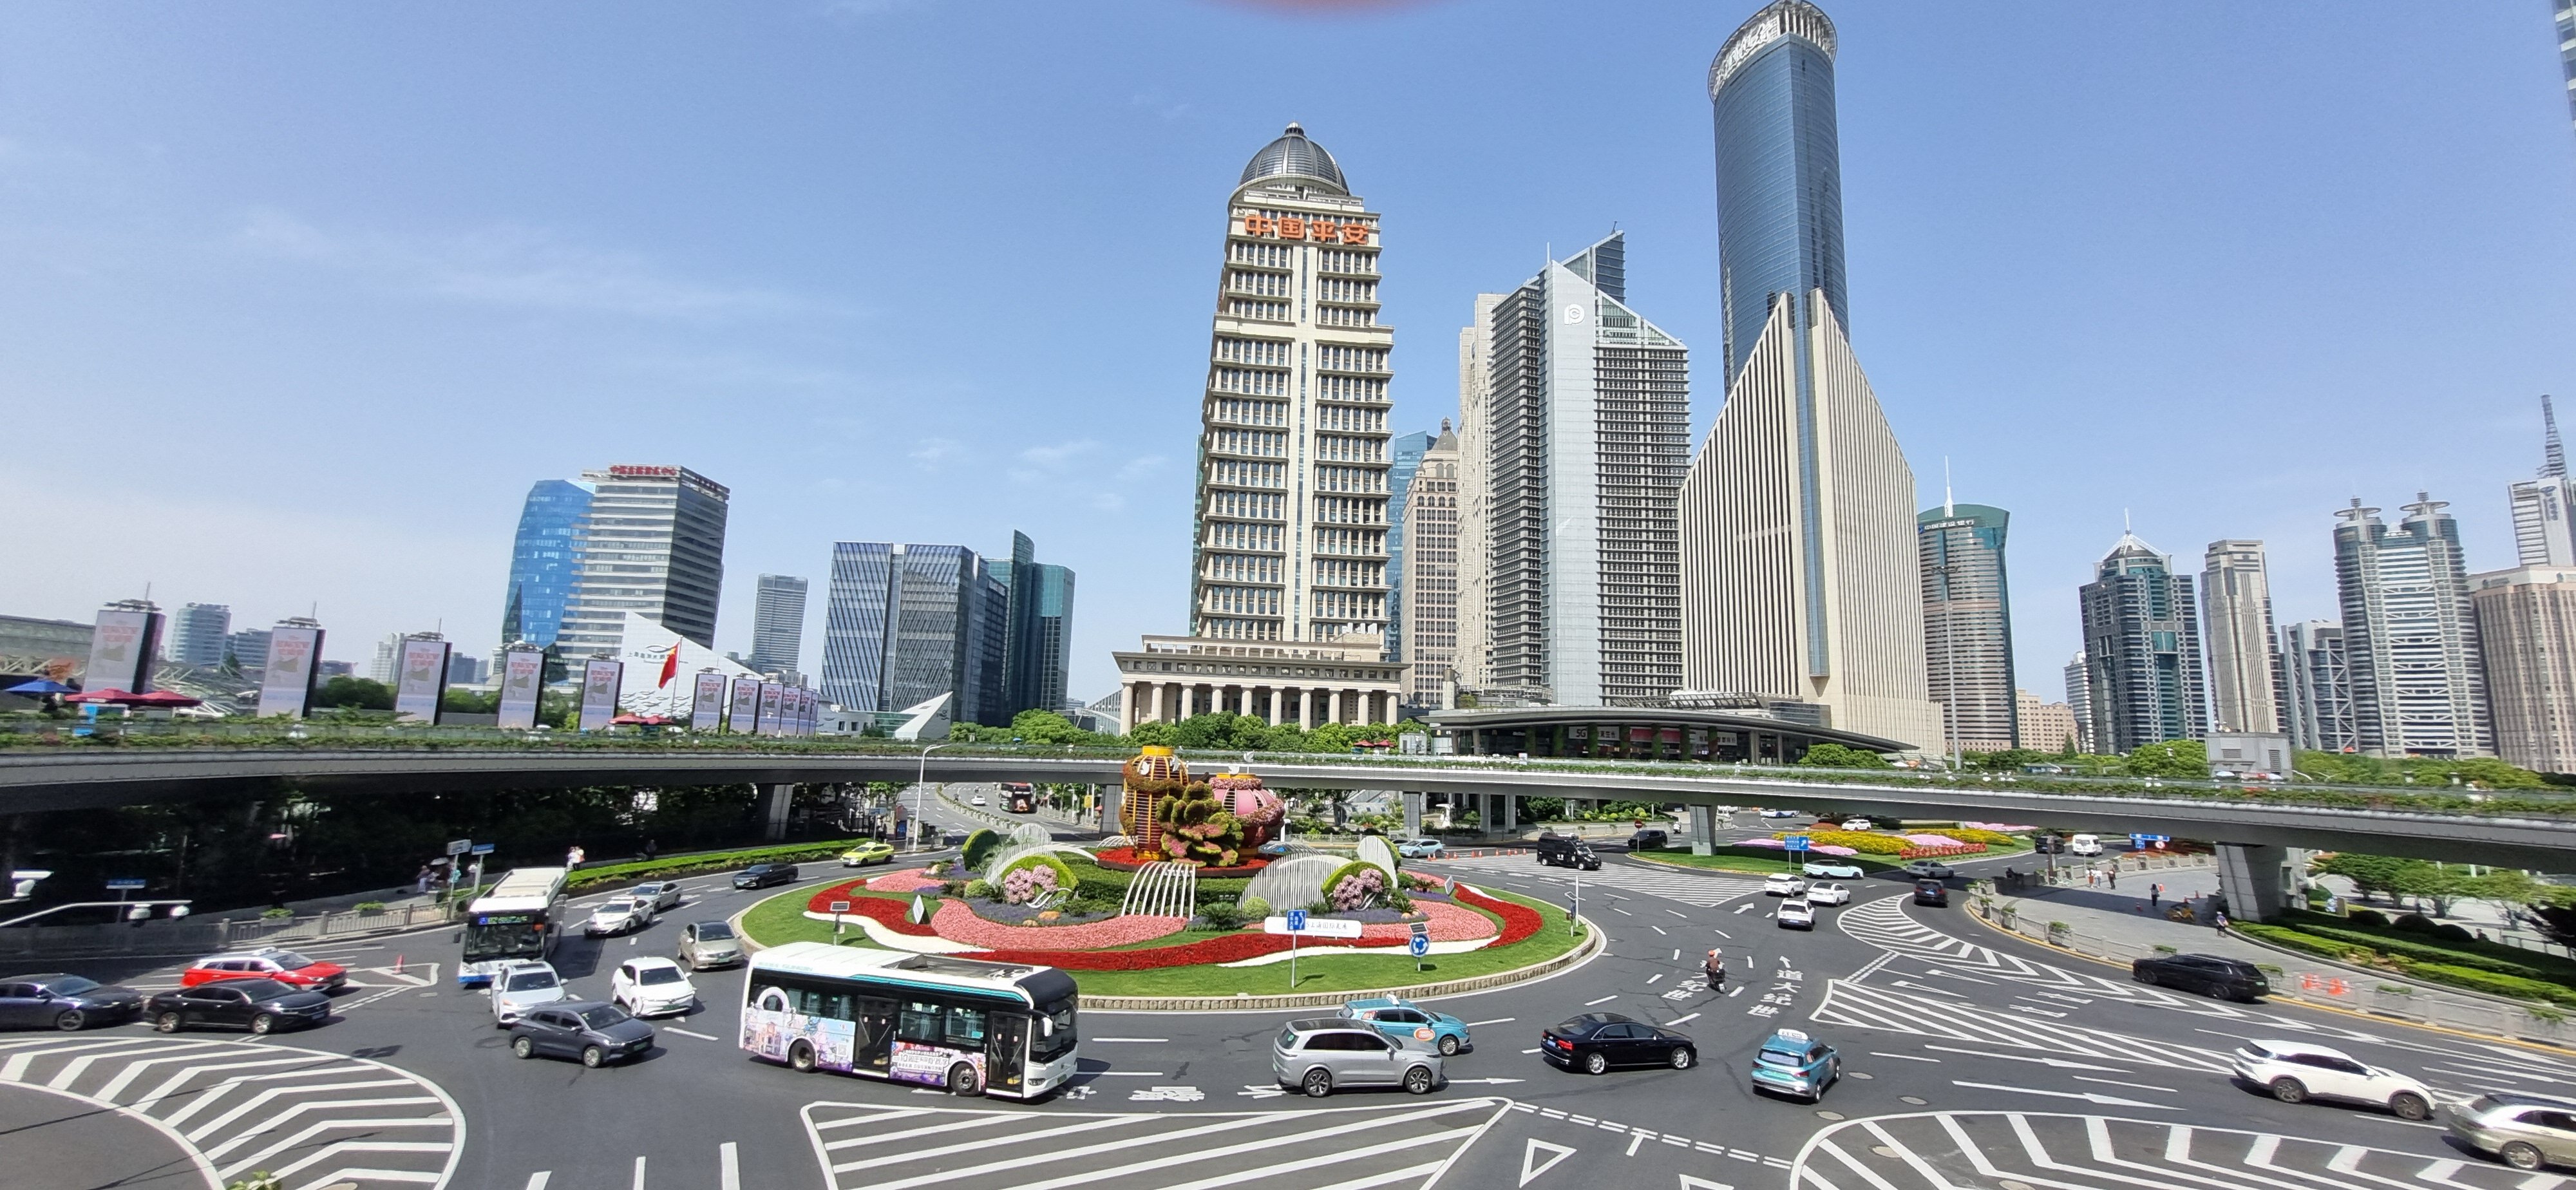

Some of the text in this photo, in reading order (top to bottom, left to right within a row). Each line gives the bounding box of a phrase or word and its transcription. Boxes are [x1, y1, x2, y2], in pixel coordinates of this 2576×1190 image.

[1245, 214, 1369, 245] 中国平安
[1747, 969, 1803, 1018] 世纪大道
